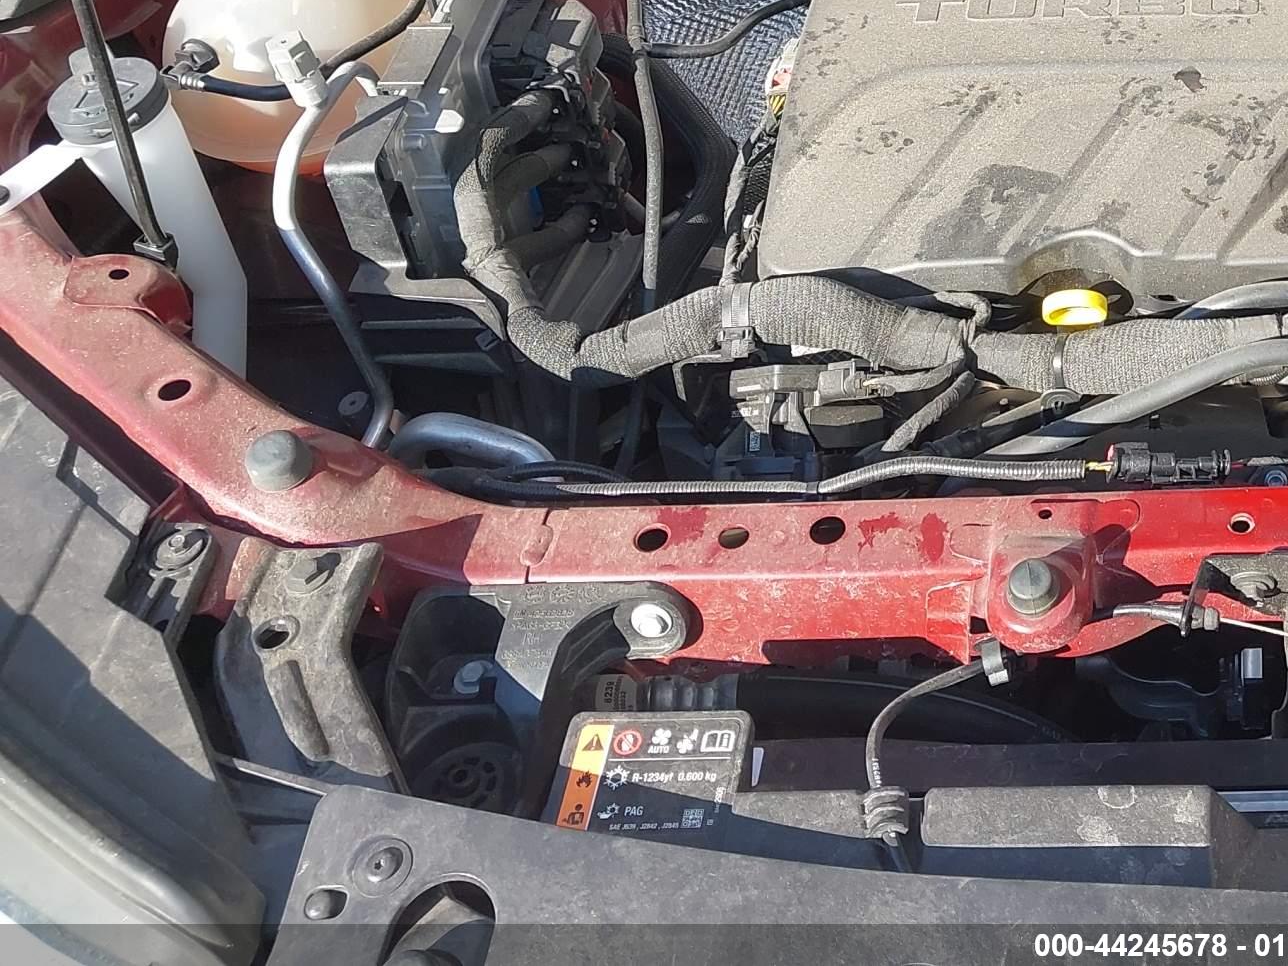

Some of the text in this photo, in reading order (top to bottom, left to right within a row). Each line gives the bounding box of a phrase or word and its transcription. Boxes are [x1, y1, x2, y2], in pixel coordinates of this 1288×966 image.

[648, 745, 670, 754] AUTO
[631, 770, 717, 784] R-1234yf 0.600 kg
[624, 805, 644, 817] PAG
